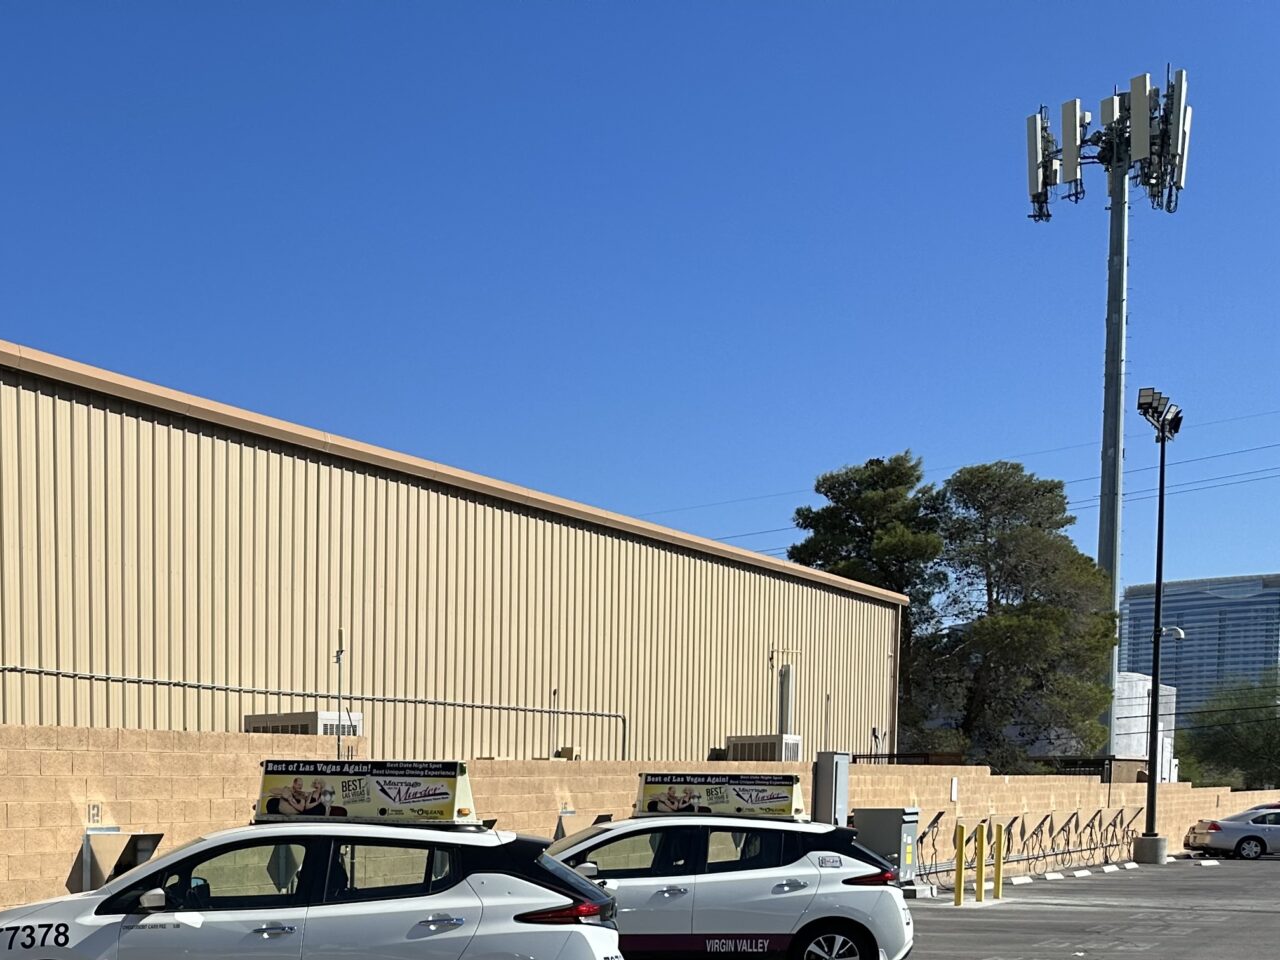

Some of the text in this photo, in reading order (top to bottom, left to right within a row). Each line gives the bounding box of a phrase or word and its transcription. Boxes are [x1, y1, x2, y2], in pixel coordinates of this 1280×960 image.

[267, 763, 371, 773] Best of Las Vegas Again!
[341, 778, 363, 792] BEST
[383, 780, 421, 788] Marriage
[706, 788, 722, 796] BEST
[5, 923, 69, 950] 7378
[706, 939, 770, 952] VIRGIN VALLEY
